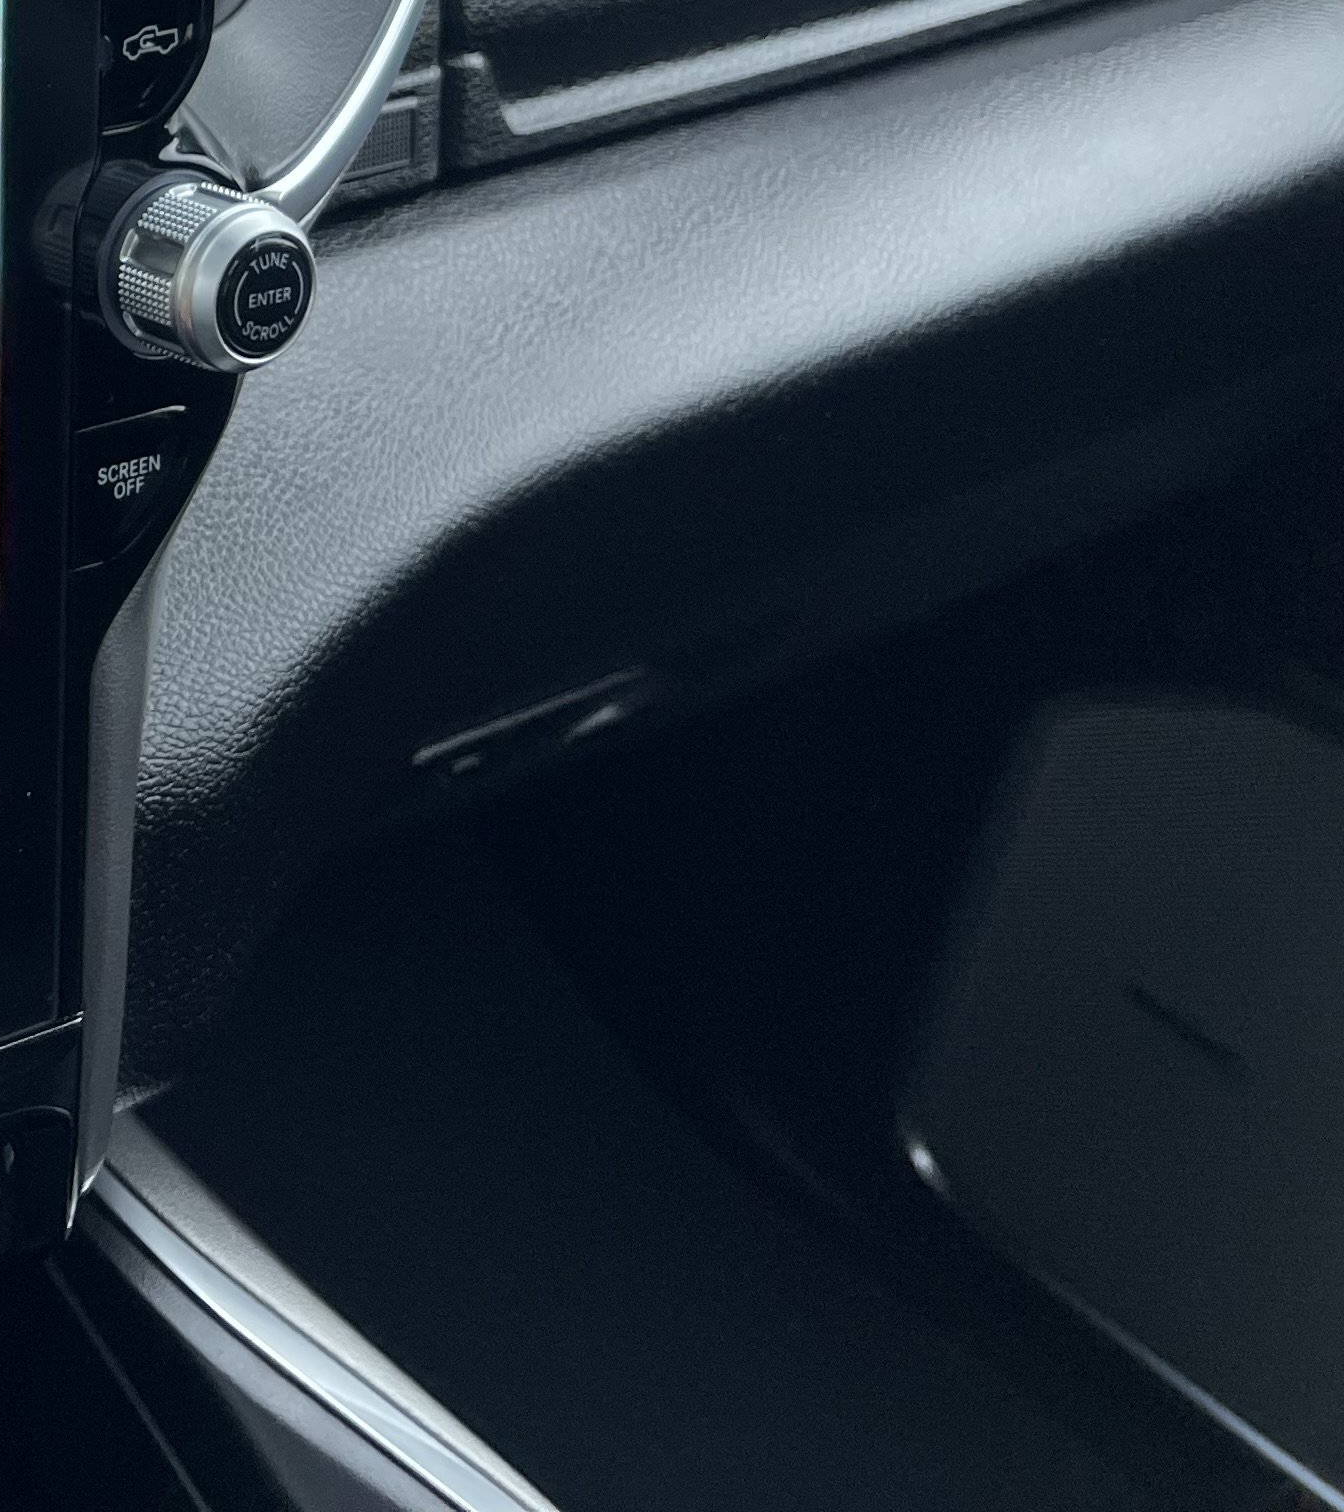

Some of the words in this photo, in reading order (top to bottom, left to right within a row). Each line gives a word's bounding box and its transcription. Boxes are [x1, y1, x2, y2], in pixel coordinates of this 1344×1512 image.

[249, 252, 290, 275] TUNE
[248, 286, 292, 310] ENTER
[242, 314, 295, 341] SCROLL
[97, 453, 161, 487] SCREEN
[113, 476, 146, 501] OFF
